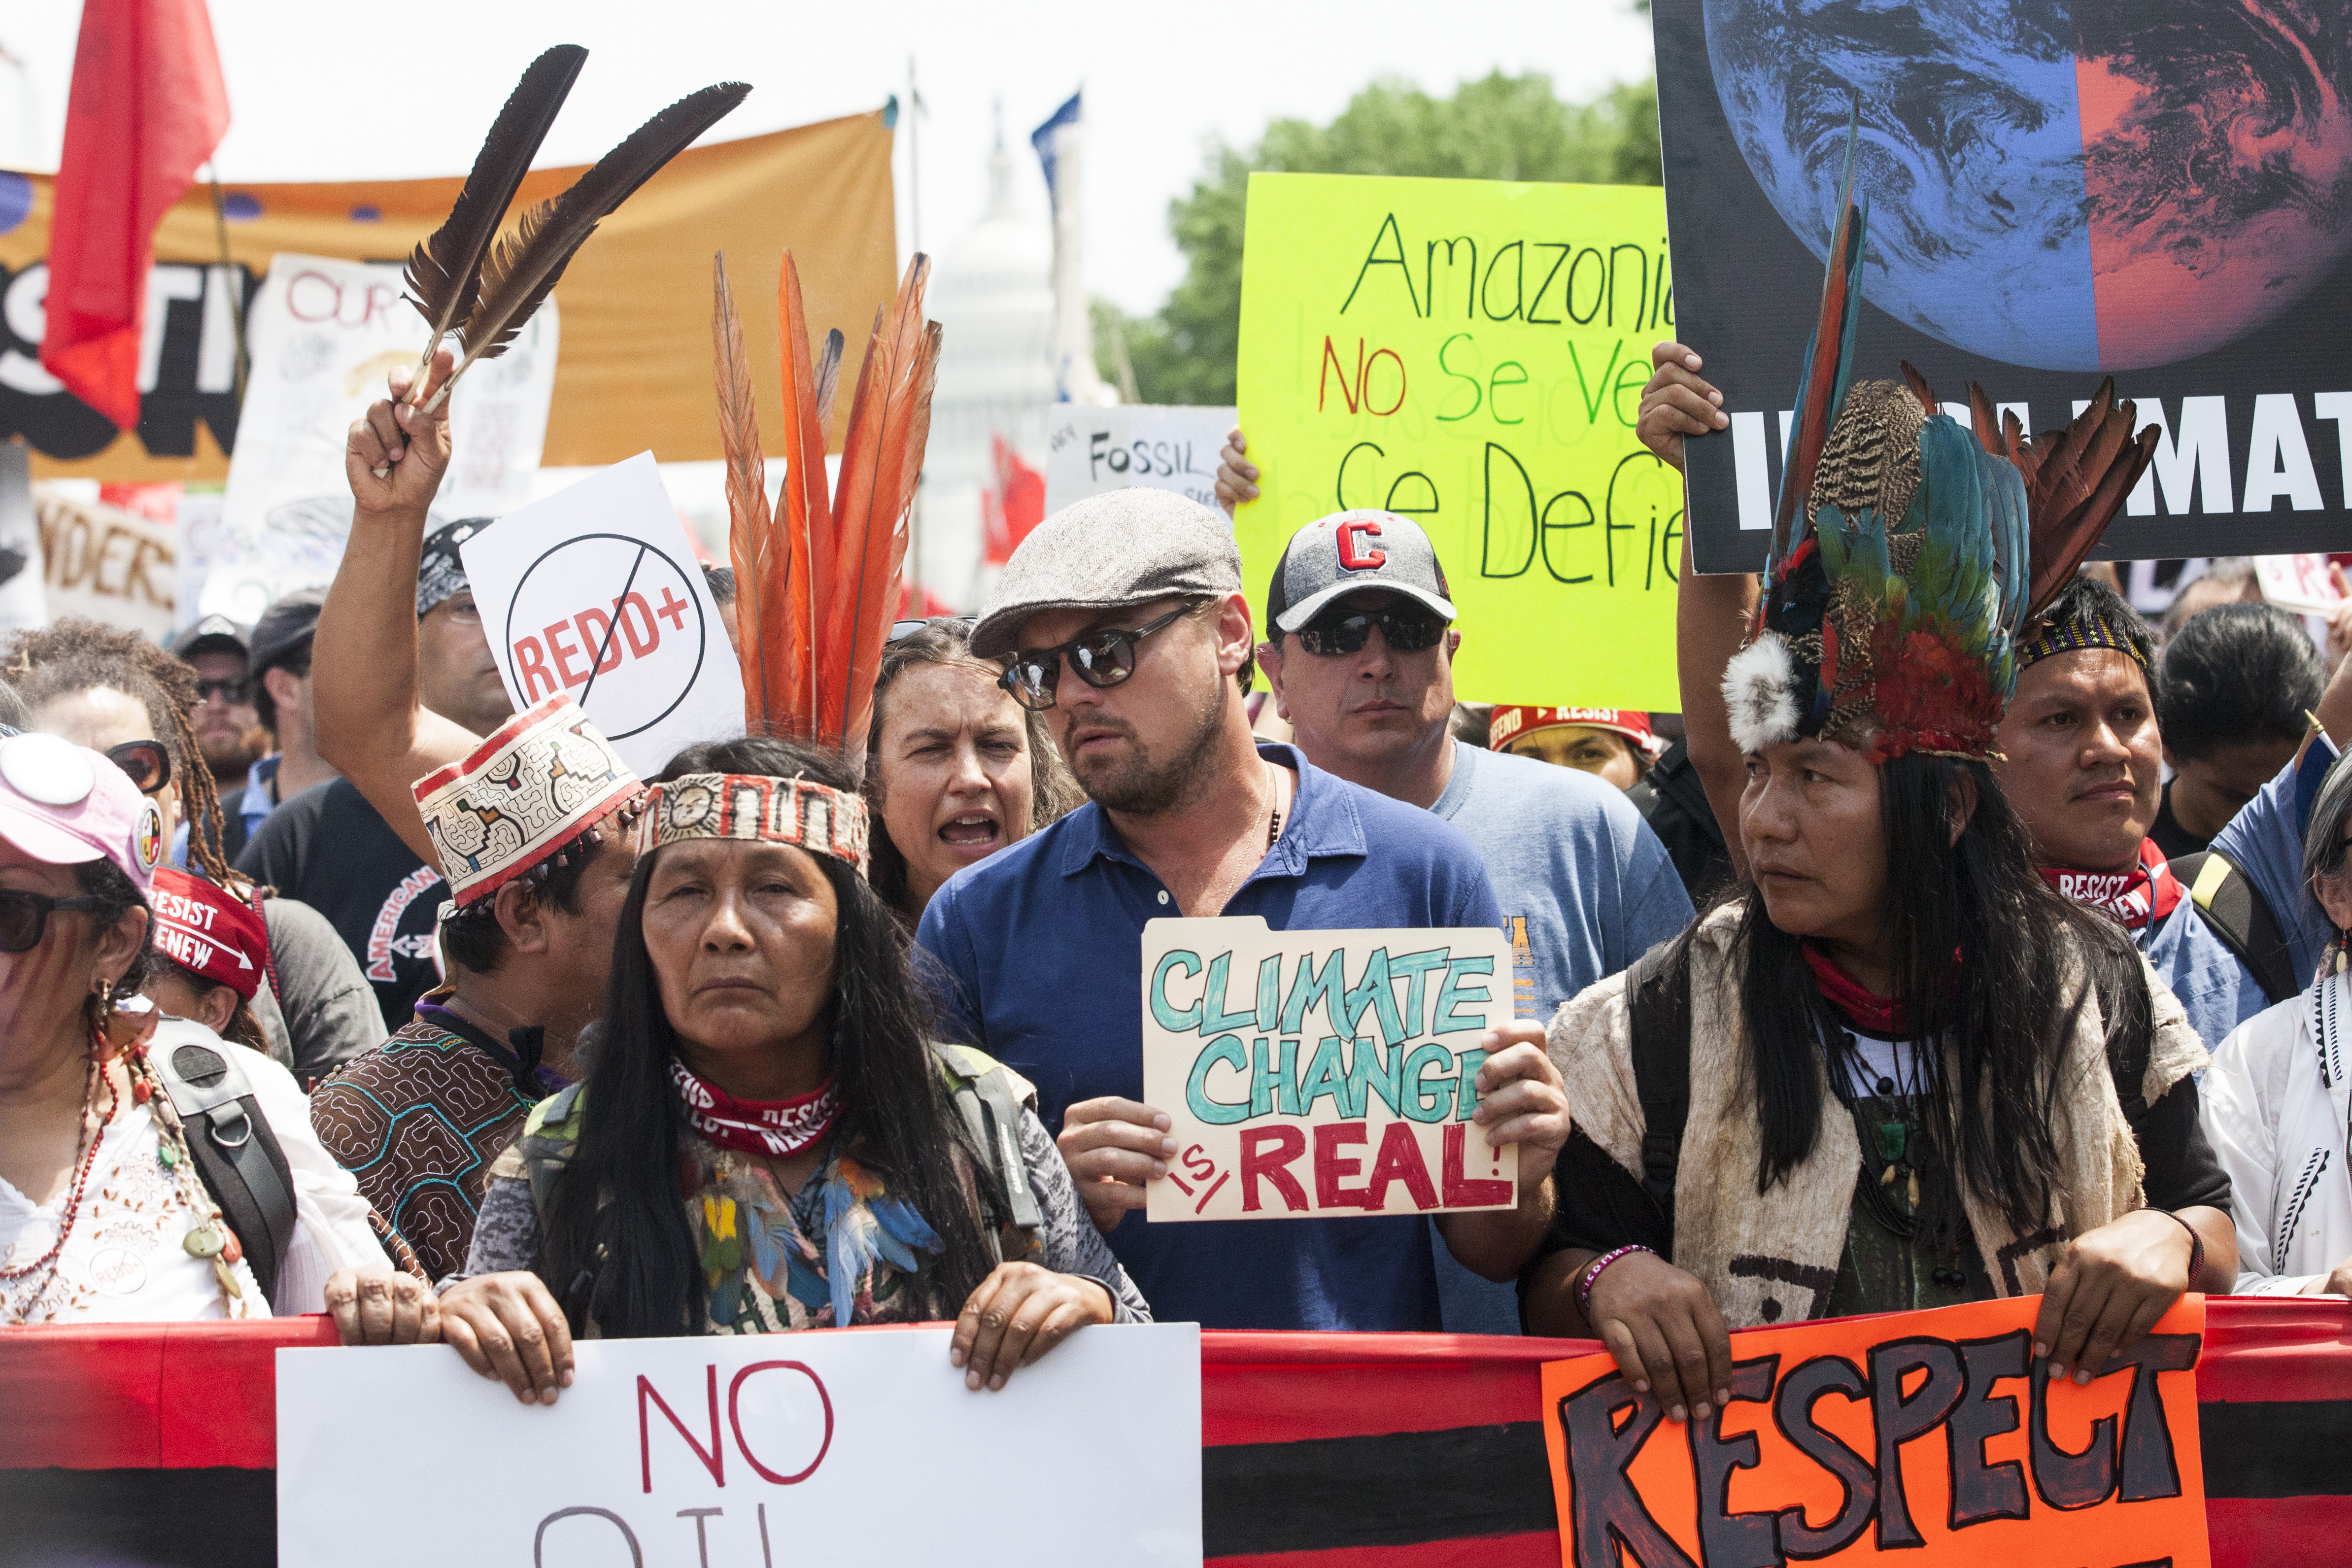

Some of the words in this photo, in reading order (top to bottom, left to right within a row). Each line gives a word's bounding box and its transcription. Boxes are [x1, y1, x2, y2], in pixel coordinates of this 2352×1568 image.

[286, 269, 394, 333] OUR
[1435, 333, 1529, 426] Se
[1730, 408, 1795, 531] I
[1940, 391, 2352, 517] MAT
[1335, 519, 1388, 574] C
[513, 586, 689, 705] REDD+
[148, 890, 219, 931] RESIST
[366, 864, 443, 983] AMERICAN
[2060, 875, 2129, 905] RESIST
[1150, 946, 1495, 1047] CLIMATE
[1167, 1143, 1218, 1197] IS
[95, 1261, 140, 1286] REDD+
[637, 1360, 834, 1494] NO
[1558, 1328, 2202, 1568] RESPECT
